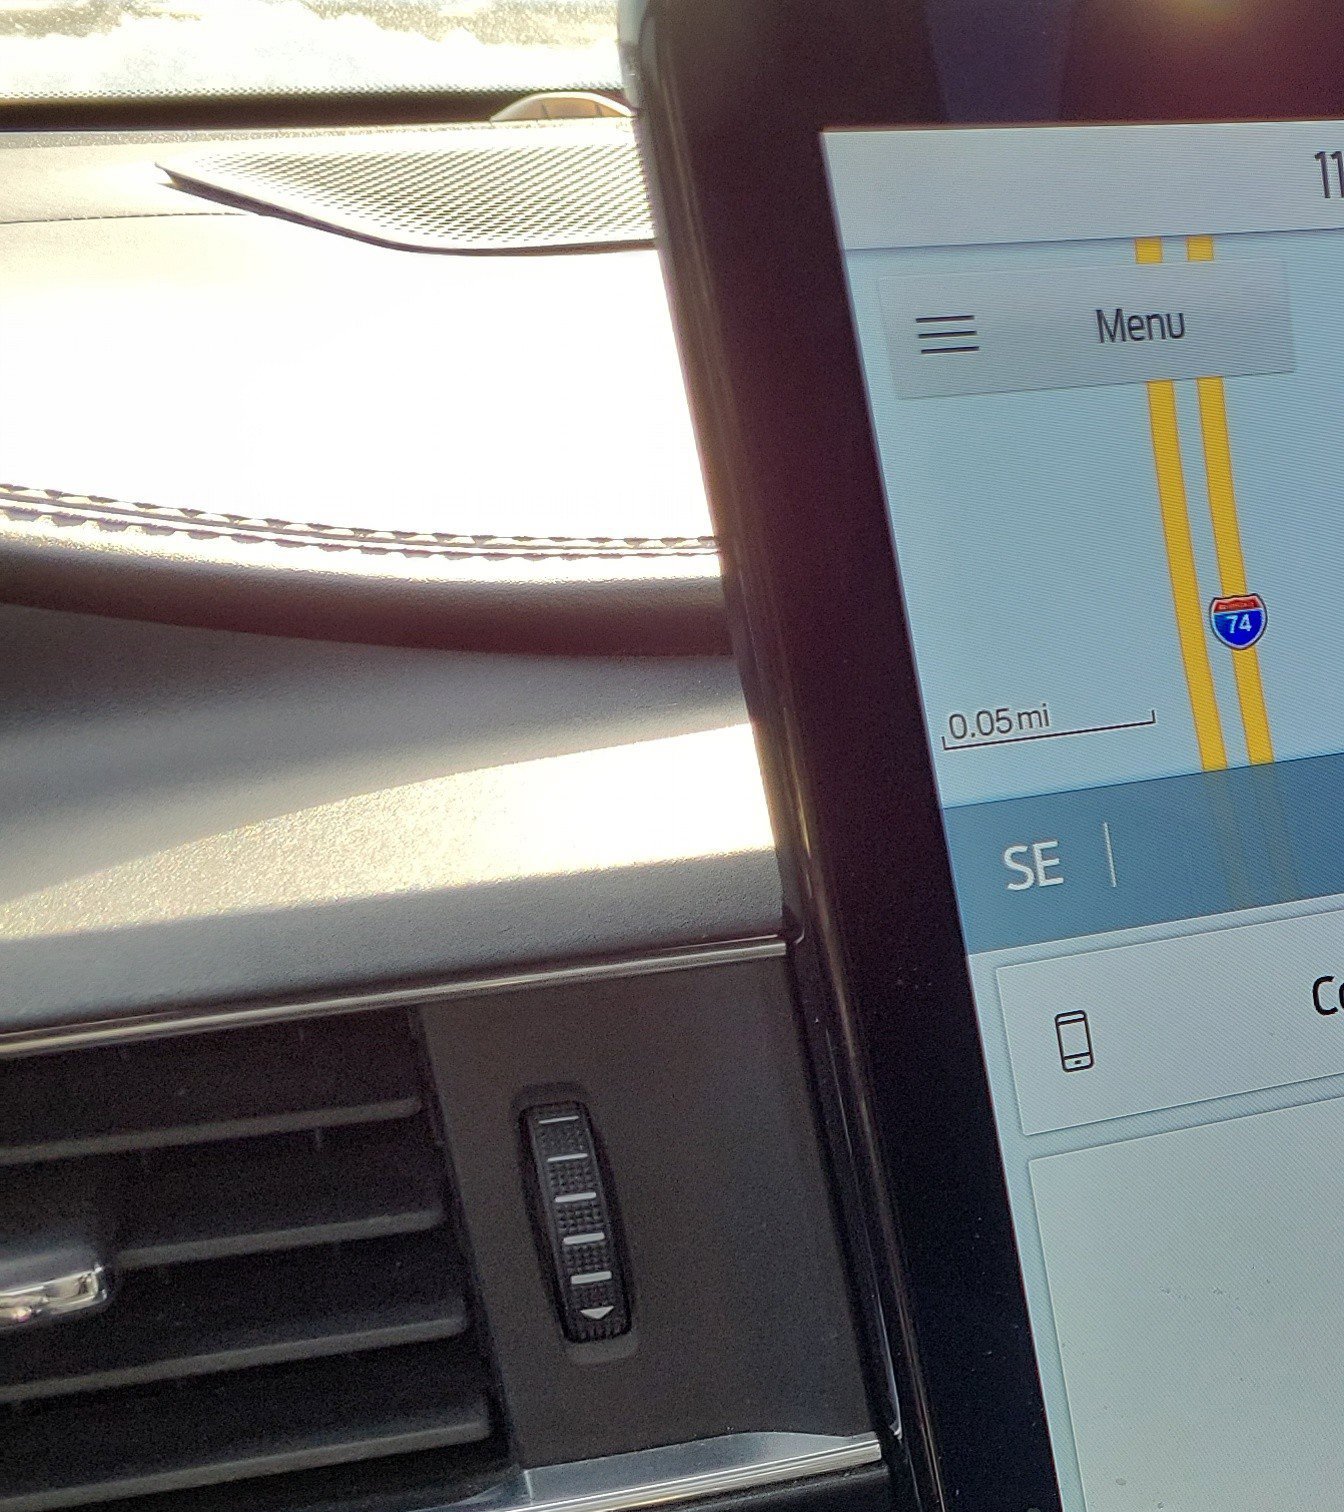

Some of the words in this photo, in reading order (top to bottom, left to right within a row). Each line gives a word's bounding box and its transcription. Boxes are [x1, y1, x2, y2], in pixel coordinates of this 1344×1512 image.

[1096, 308, 1186, 343] Menu
[1226, 613, 1252, 634] 74
[1003, 840, 1064, 891] SE
